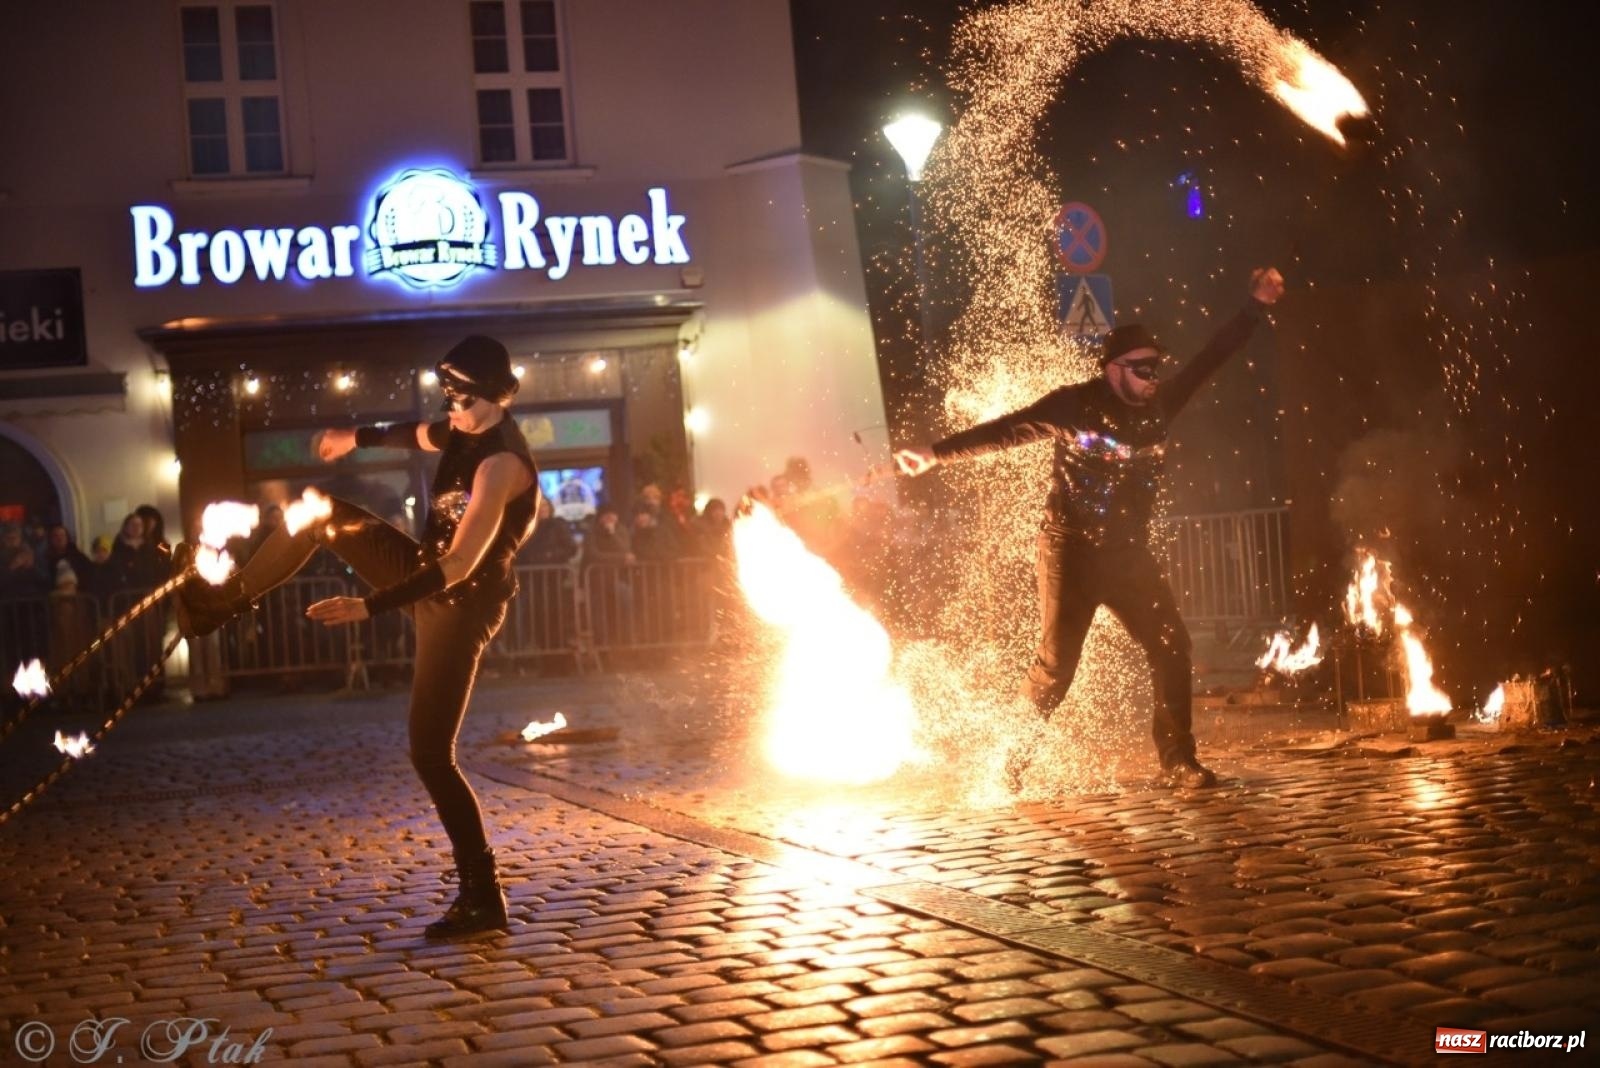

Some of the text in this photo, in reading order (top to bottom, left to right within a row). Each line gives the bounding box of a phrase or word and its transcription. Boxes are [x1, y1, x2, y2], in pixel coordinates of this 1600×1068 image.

[130, 187, 690, 287] Browar Rynek
[381, 240, 484, 269] Browar Rynek
